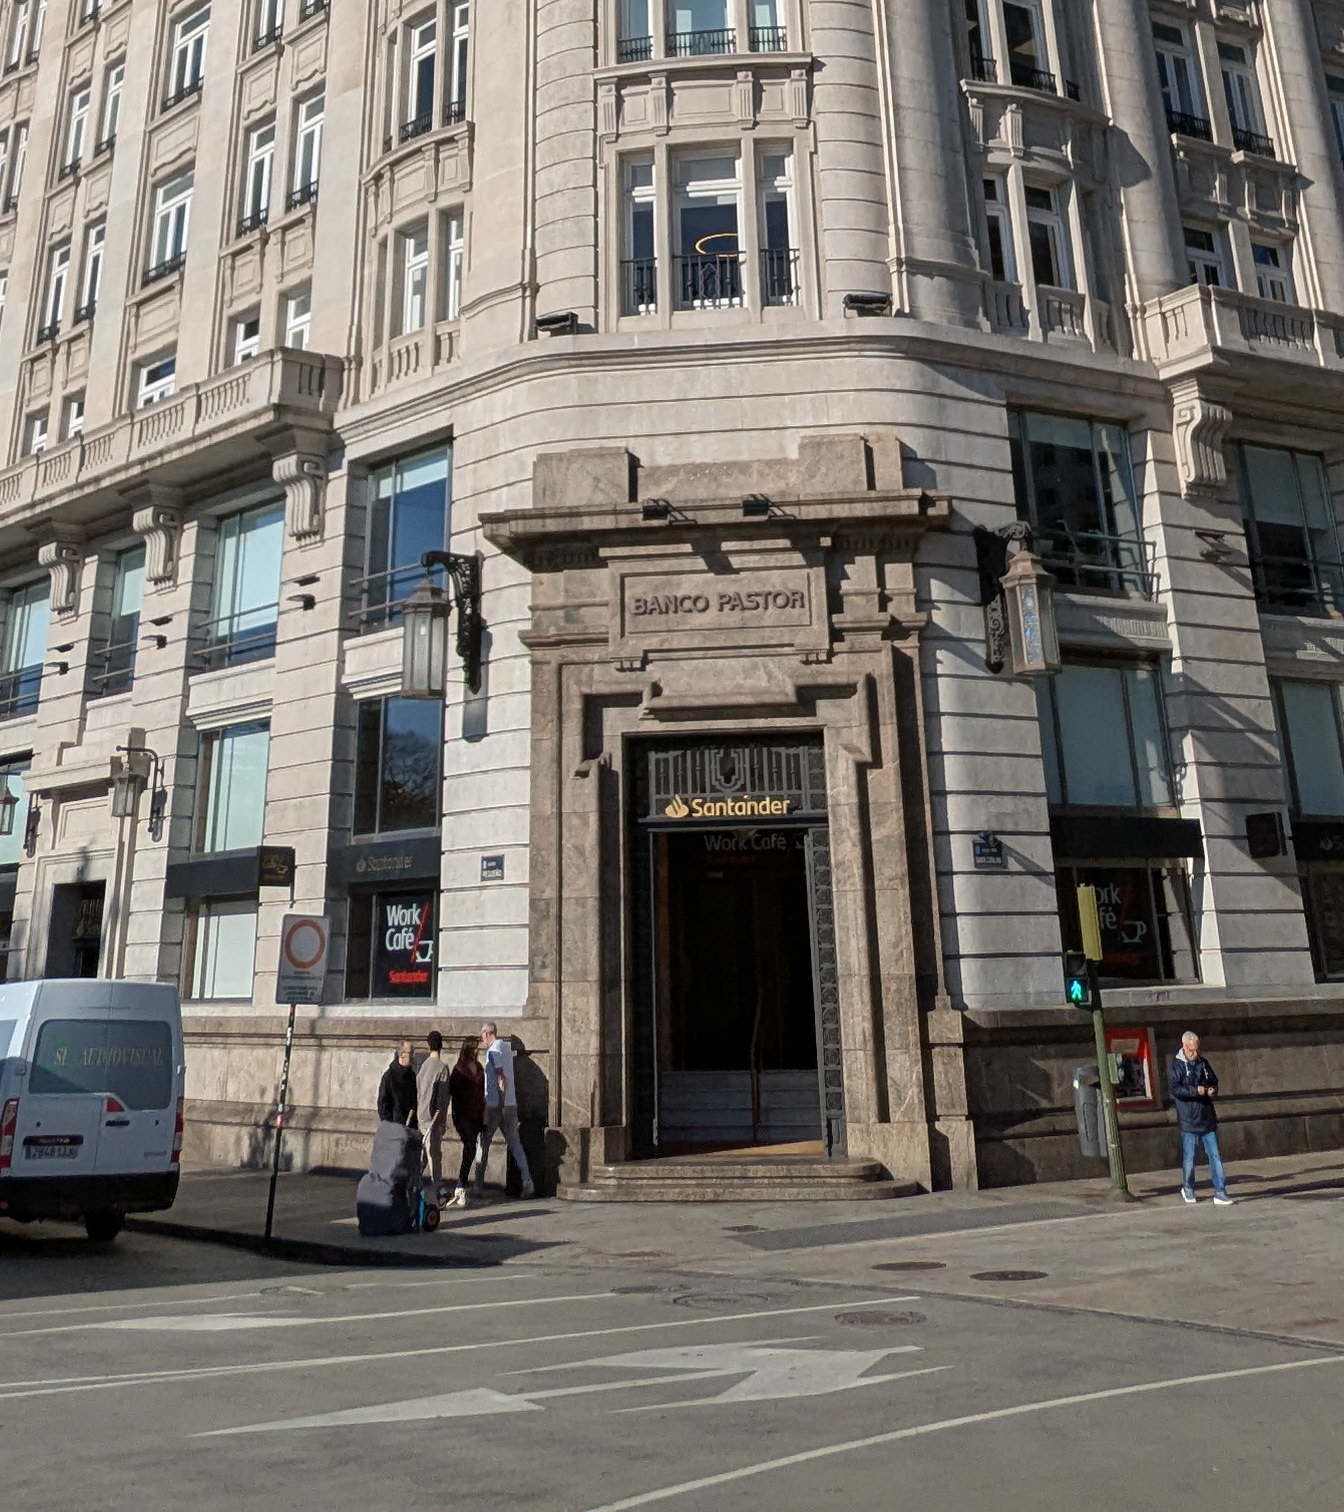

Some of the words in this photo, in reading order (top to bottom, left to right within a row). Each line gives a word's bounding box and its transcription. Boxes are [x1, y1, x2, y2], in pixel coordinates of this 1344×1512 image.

[632, 593, 710, 616] BANCO
[716, 590, 806, 612] PASTOR
[691, 796, 790, 817] Santander
[704, 832, 747, 851] Work
[751, 832, 787, 850] Café
[367, 855, 414, 872] Santander
[1096, 882, 1122, 904] ork
[386, 903, 421, 926] Work
[385, 927, 414, 951] Café
